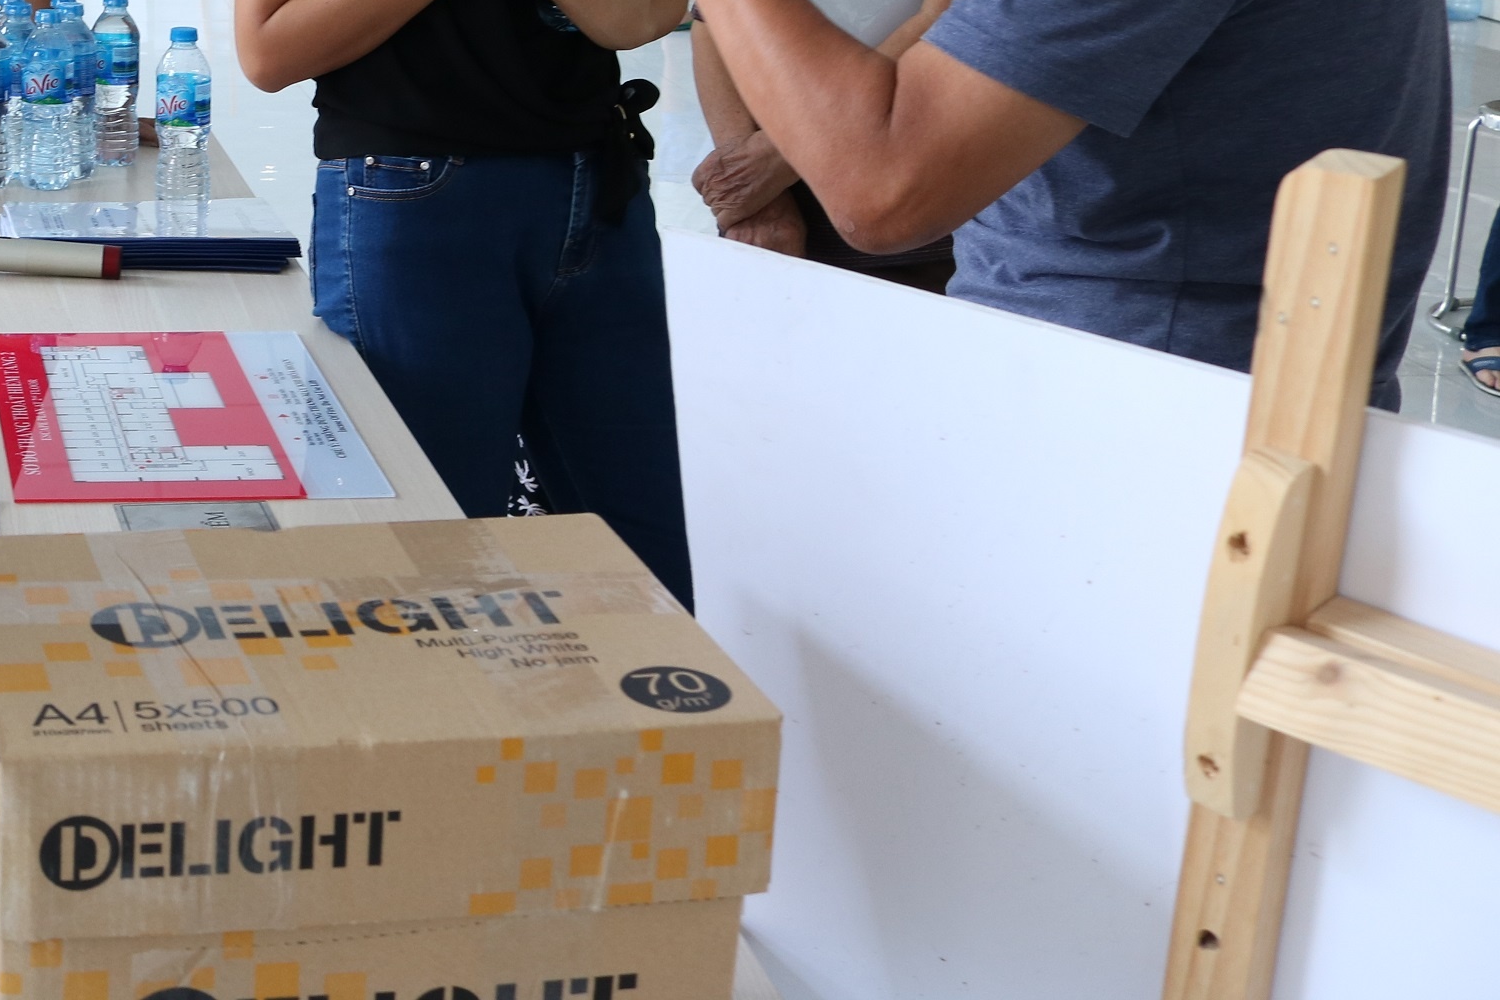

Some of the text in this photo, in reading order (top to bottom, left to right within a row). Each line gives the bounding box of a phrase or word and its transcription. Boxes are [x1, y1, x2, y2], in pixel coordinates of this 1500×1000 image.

[14, 421, 34, 449] THANG
[90, 590, 563, 649] DELIGHT
[456, 642, 589, 660] High White
[510, 654, 600, 669] No jam
[629, 671, 708, 696] 70
[32, 696, 280, 727] A4 5x500
[140, 719, 230, 733] sheets
[39, 811, 401, 891] DELIGHT
